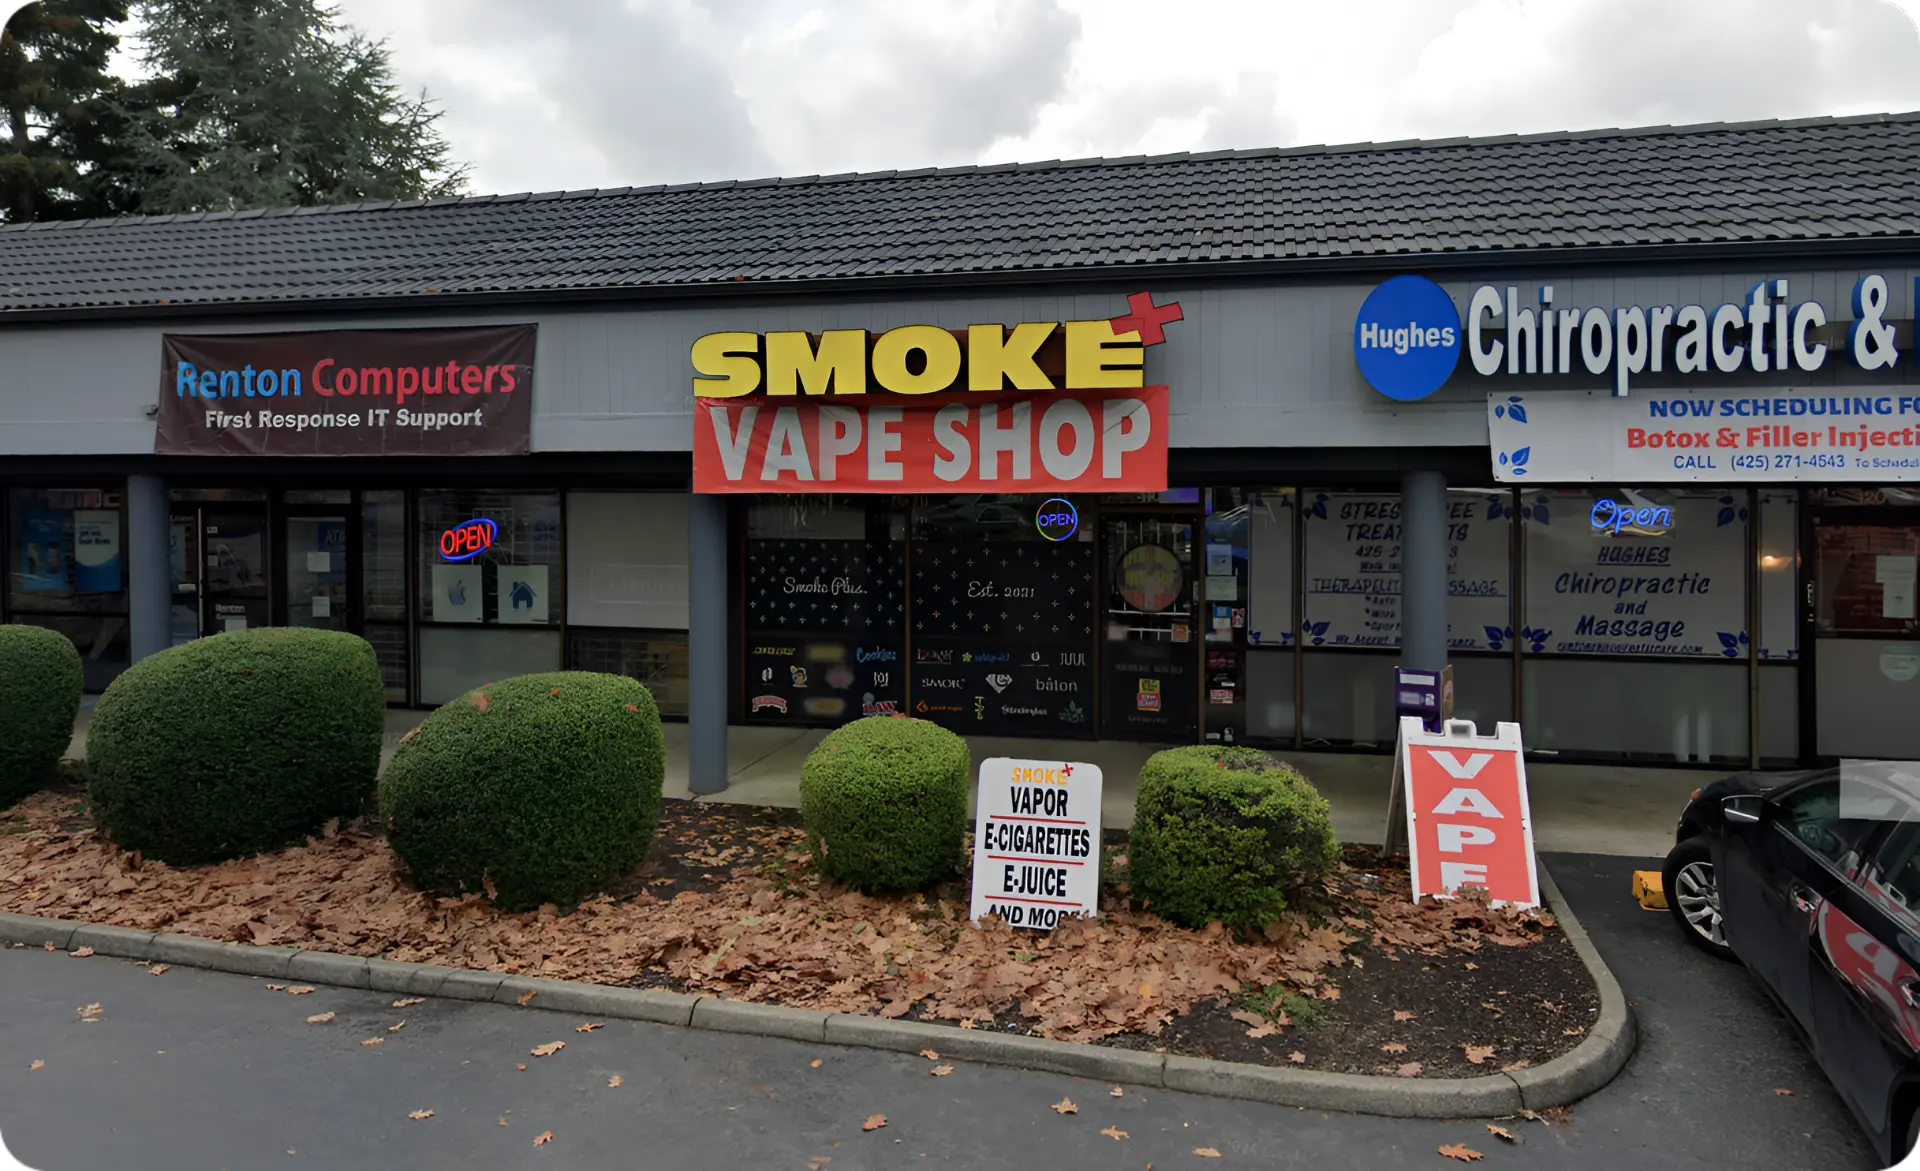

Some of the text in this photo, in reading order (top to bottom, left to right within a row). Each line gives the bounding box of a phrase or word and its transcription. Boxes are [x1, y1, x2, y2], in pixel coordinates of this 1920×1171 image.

[1360, 321, 1456, 354] Hughes
[1468, 274, 1898, 396] Chiropractic &
[176, 359, 516, 405] Renton Computers
[206, 408, 483, 432] First Response IT Support
[1649, 399, 1713, 418] NOW
[1719, 397, 1891, 417] SCHEDULING
[709, 398, 1151, 482] VAPE SHOP
[1627, 427, 1709, 450] Botox
[1715, 427, 1740, 449] &
[1746, 425, 1822, 448] Filler
[1673, 455, 1716, 469] CALL
[1730, 455, 1769, 471] (425)
[1037, 512, 1076, 528] OPEN
[1340, 502, 1402, 519] STRES
[1591, 497, 1671, 534] Open
[440, 523, 492, 556] OPEN
[1597, 546, 1671, 563] HUGHES
[967, 580, 999, 598] Est.
[1555, 573, 1710, 598] Chiropractic
[1614, 601, 1646, 615] and
[1575, 616, 1684, 641] Massage
[1010, 786, 1069, 817] VAPOR
